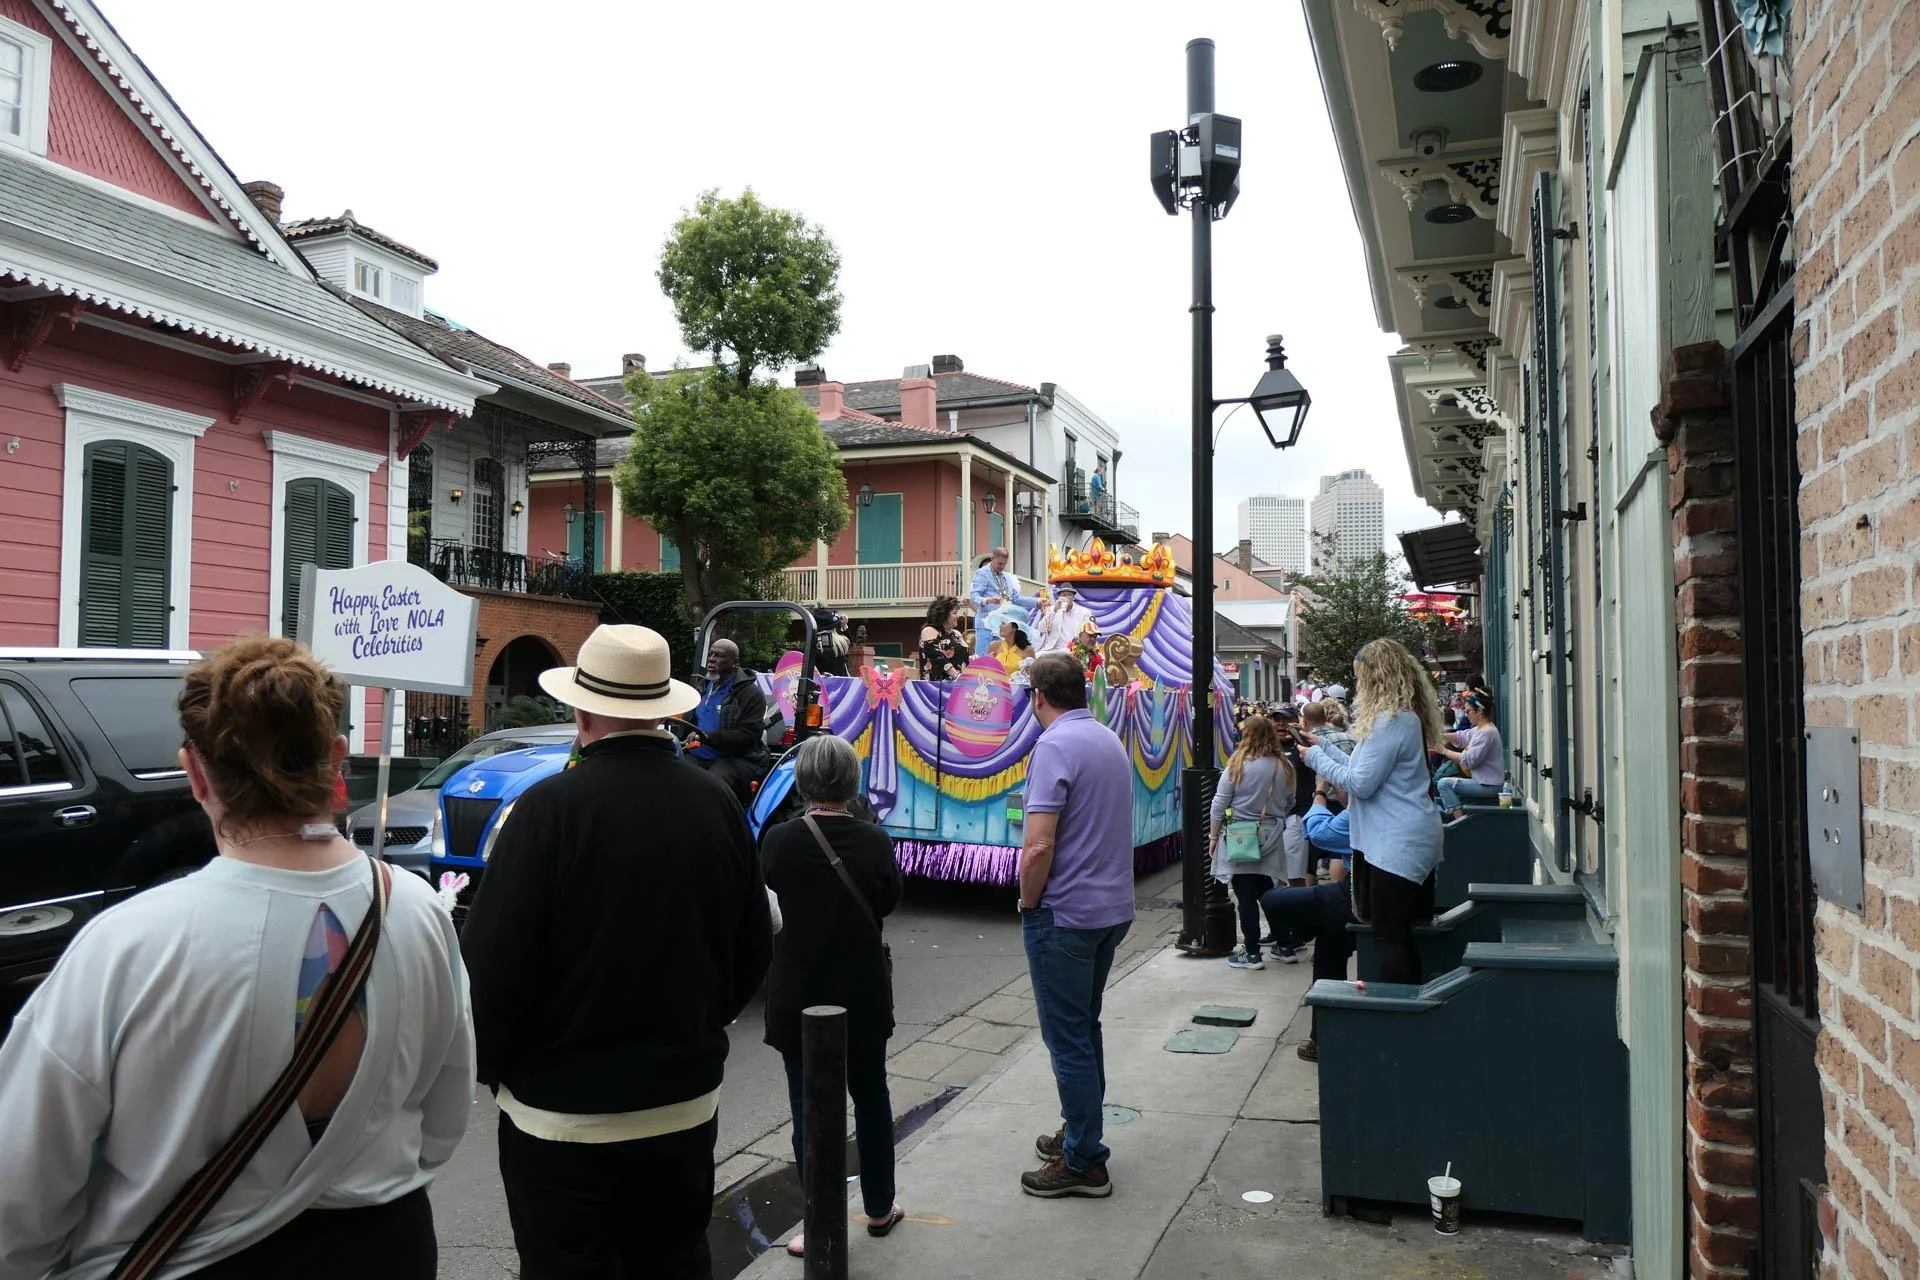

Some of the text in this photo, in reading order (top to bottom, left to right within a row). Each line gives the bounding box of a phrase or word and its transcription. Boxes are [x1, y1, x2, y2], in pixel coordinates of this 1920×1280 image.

[329, 584, 422, 615] Happy Easter
[334, 608, 445, 637] with Love NOLA
[352, 635, 423, 660] Celebrities
